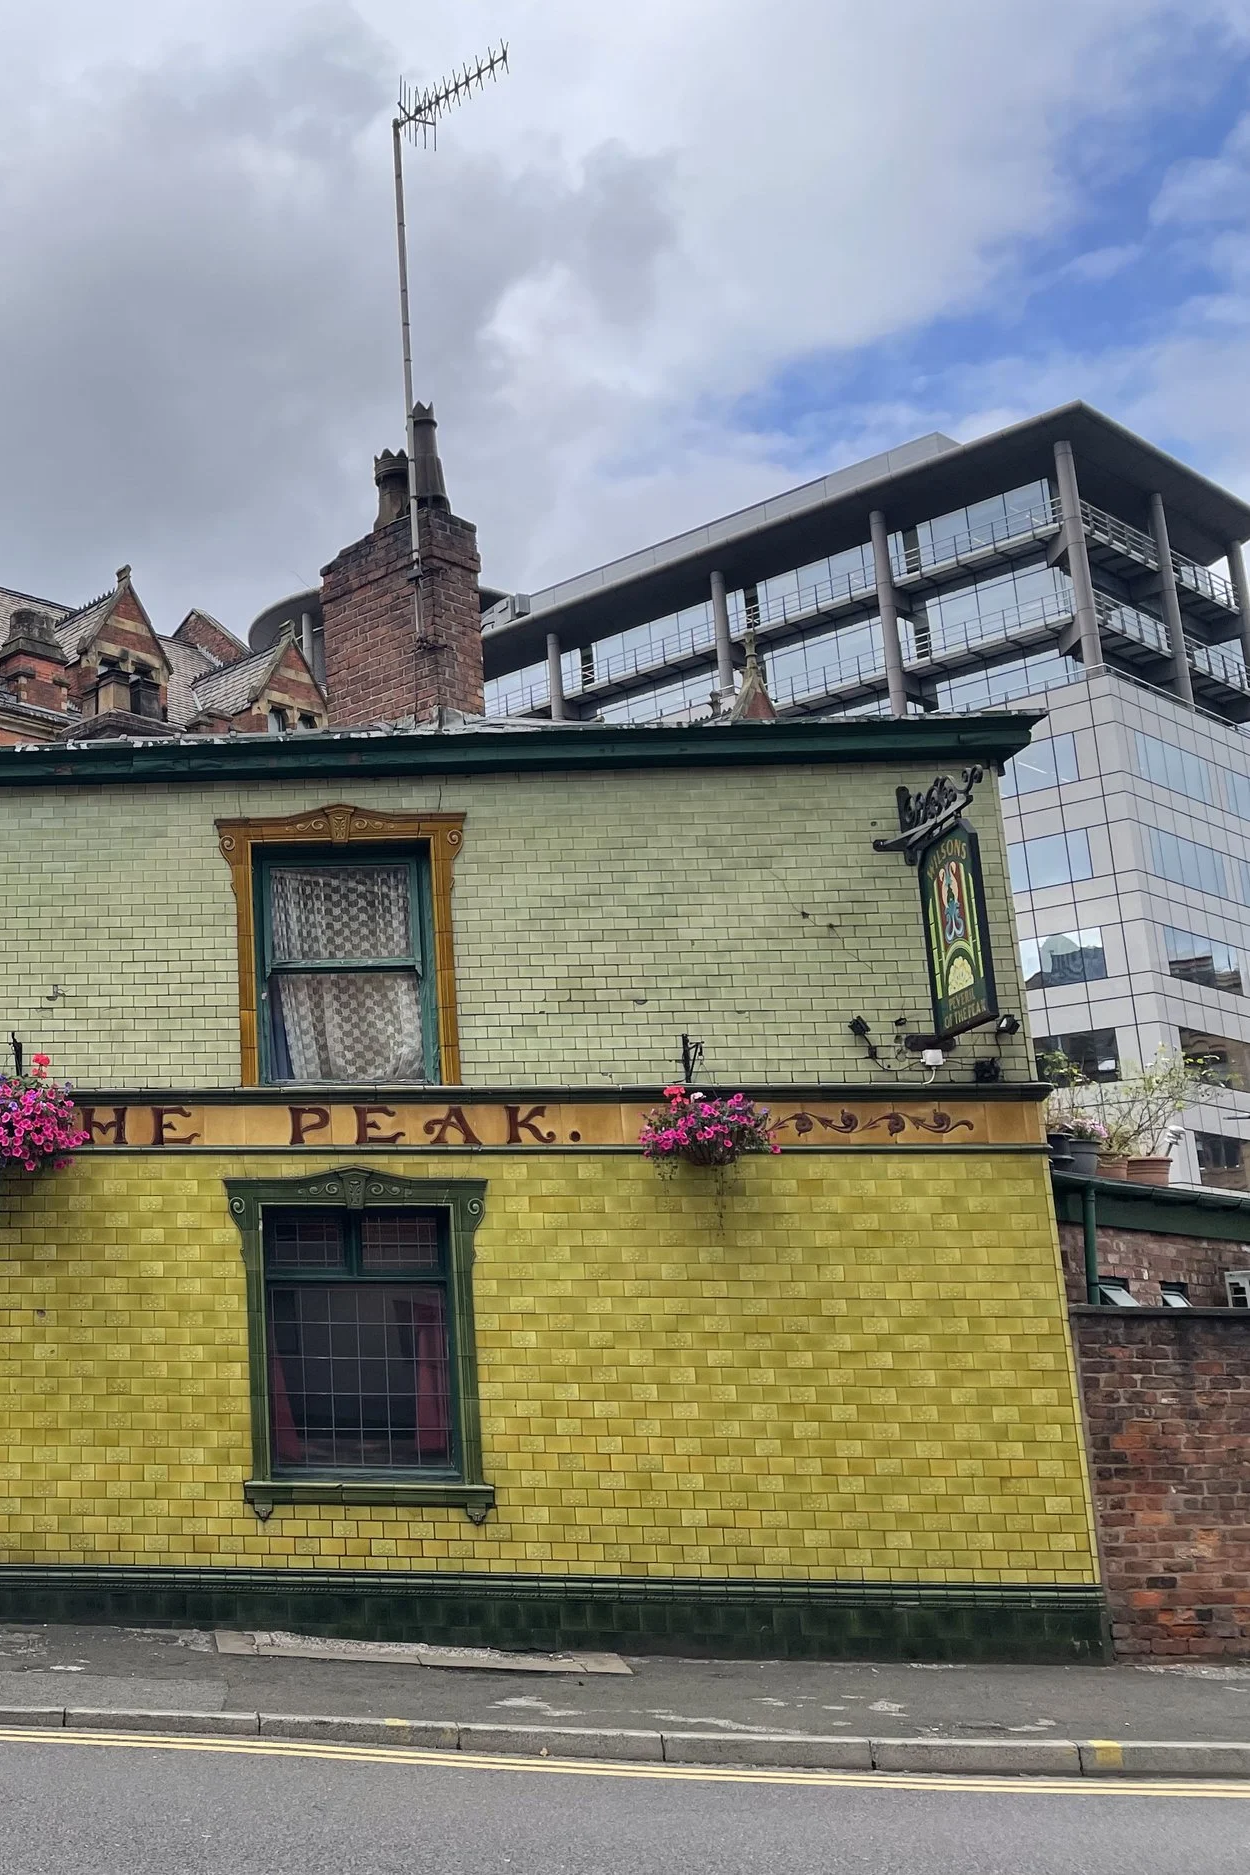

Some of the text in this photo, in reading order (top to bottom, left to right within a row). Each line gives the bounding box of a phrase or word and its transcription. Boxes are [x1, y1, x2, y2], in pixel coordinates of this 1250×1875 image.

[927, 838, 967, 880] WILSONS
[79, 1106, 201, 1146] HE
[288, 1105, 582, 1146] PEAK.
